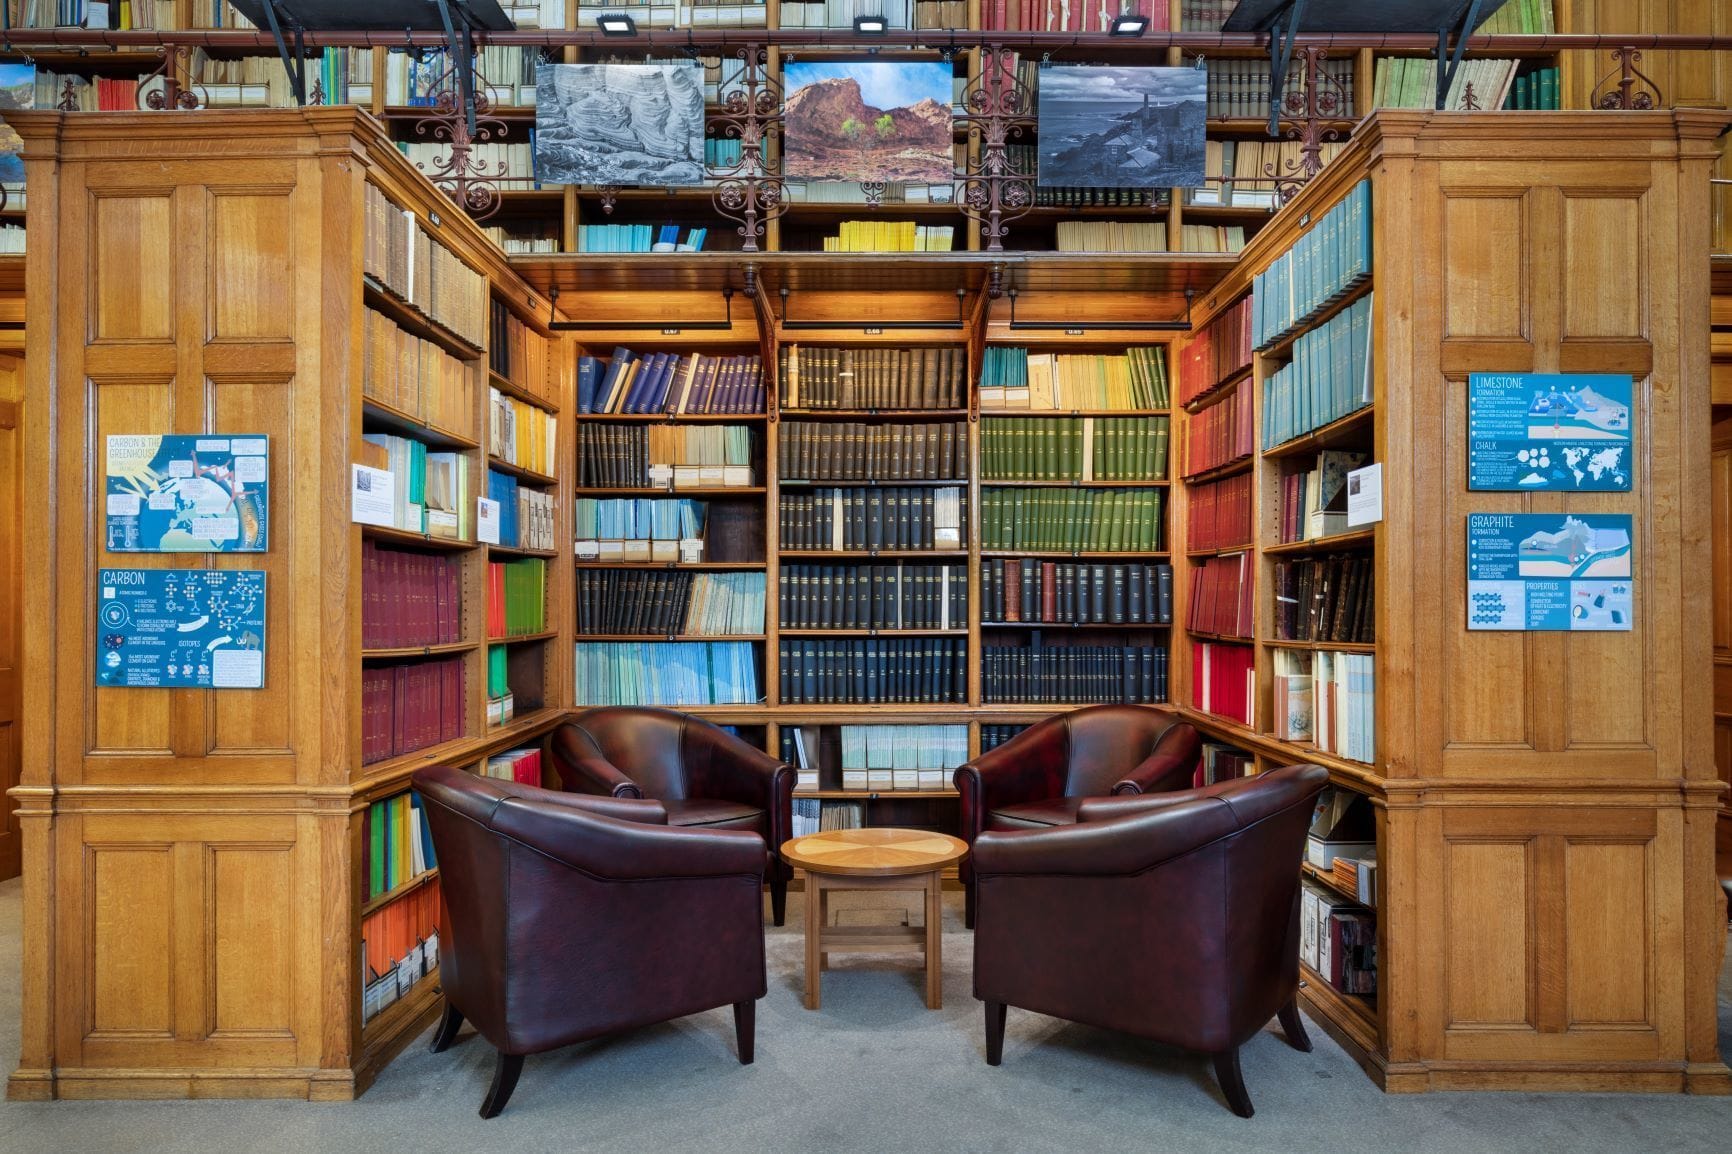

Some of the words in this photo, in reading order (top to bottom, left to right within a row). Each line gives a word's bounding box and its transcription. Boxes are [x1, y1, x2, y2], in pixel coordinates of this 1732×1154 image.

[1476, 376, 1524, 388] LIMESTONE
[109, 438, 138, 447] CARBON
[148, 438, 160, 447] THE
[1476, 441, 1496, 450] CHALK
[110, 448, 156, 458] GREENHOUSE
[1472, 516, 1514, 528] GRAPHITE
[104, 571, 145, 584] CARBON
